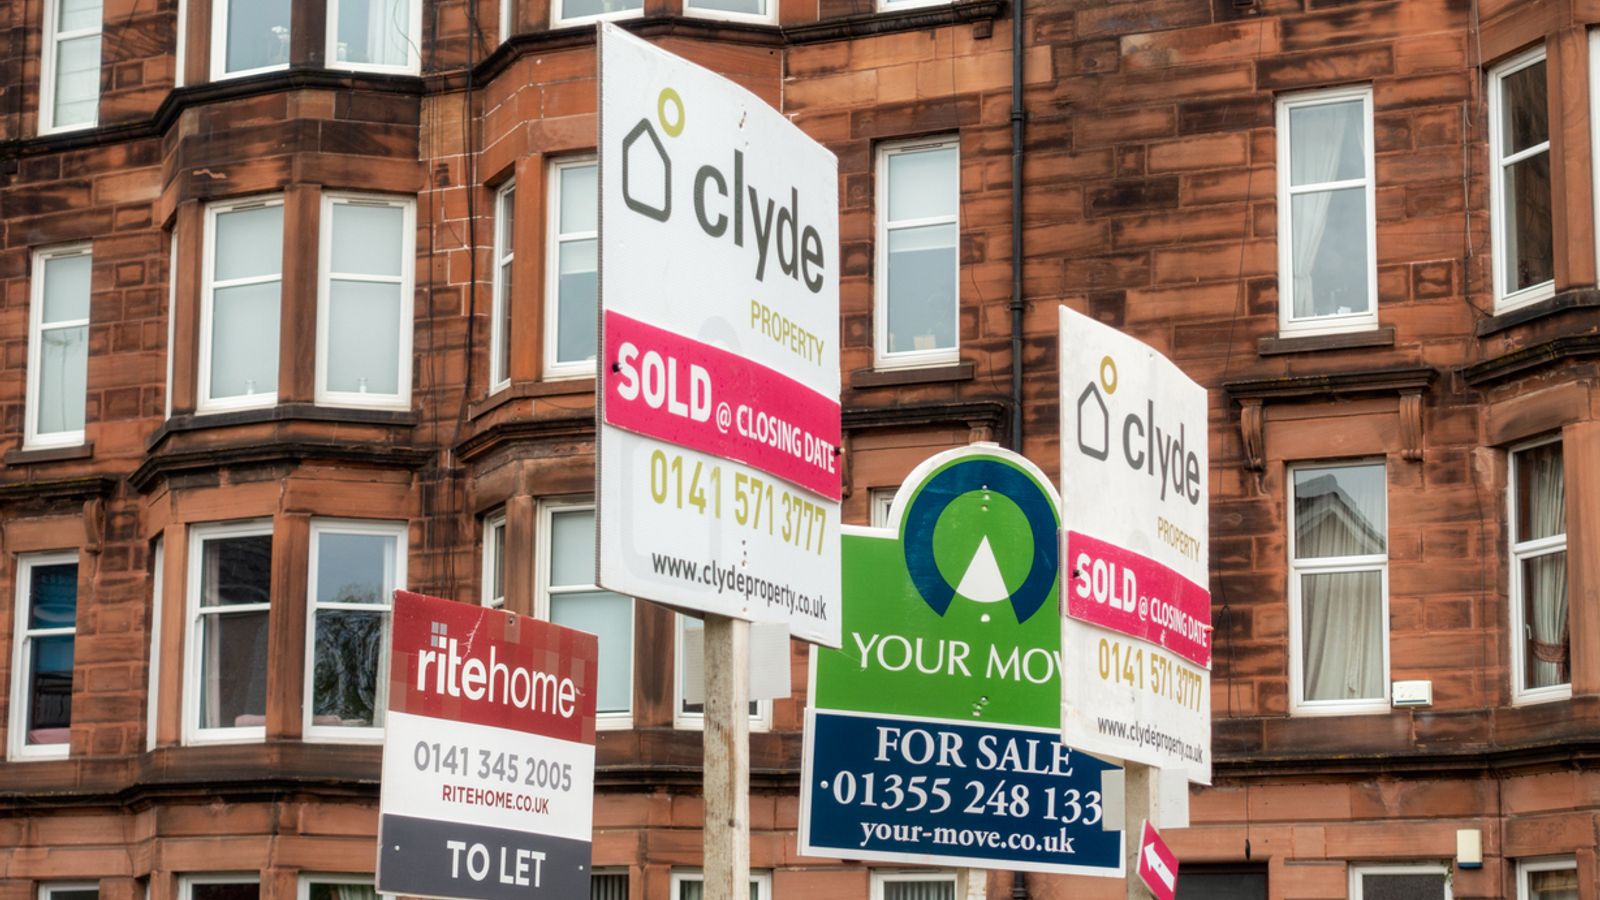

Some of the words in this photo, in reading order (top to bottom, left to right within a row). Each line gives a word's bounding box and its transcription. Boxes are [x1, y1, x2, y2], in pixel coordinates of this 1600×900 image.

[693, 148, 824, 293] clyde
[751, 300, 824, 366] PROPERTY
[617, 342, 712, 423] SOLD
[716, 402, 732, 434] @
[736, 405, 802, 457] CLOSING
[804, 431, 835, 474] DATE
[1122, 399, 1200, 506] clyde
[650, 449, 721, 519] 0141
[735, 471, 773, 536] 571
[781, 491, 826, 555] 3777
[1157, 515, 1201, 563] PROPERTY
[652, 552, 827, 621] www.clydeproperty.co.uk
[1076, 552, 1137, 613] SOLD
[1138, 596, 1149, 621] @
[1151, 597, 1187, 638] CLOSING
[1188, 611, 1207, 648] DATE
[417, 636, 576, 718] ritehome
[852, 632, 972, 677] YOUR
[1099, 638, 1144, 690] 0141
[1151, 652, 1173, 700] 571
[1176, 664, 1203, 713] 3777
[414, 741, 469, 777] 0141
[477, 749, 519, 783] 345
[524, 757, 572, 792] 2005
[874, 726, 967, 768] FOR
[976, 734, 1074, 777] SALE
[1097, 716, 1204, 764] www.clydeproperty.co.uk
[442, 784, 549, 815] RITEHOME.CO.UK
[832, 770, 951, 814] 01355
[963, 779, 1030, 818] 248
[1043, 786, 1103, 826] 133
[447, 840, 490, 882] TO
[499, 846, 546, 888] LET
[859, 820, 1076, 855] your-move.co.uk
